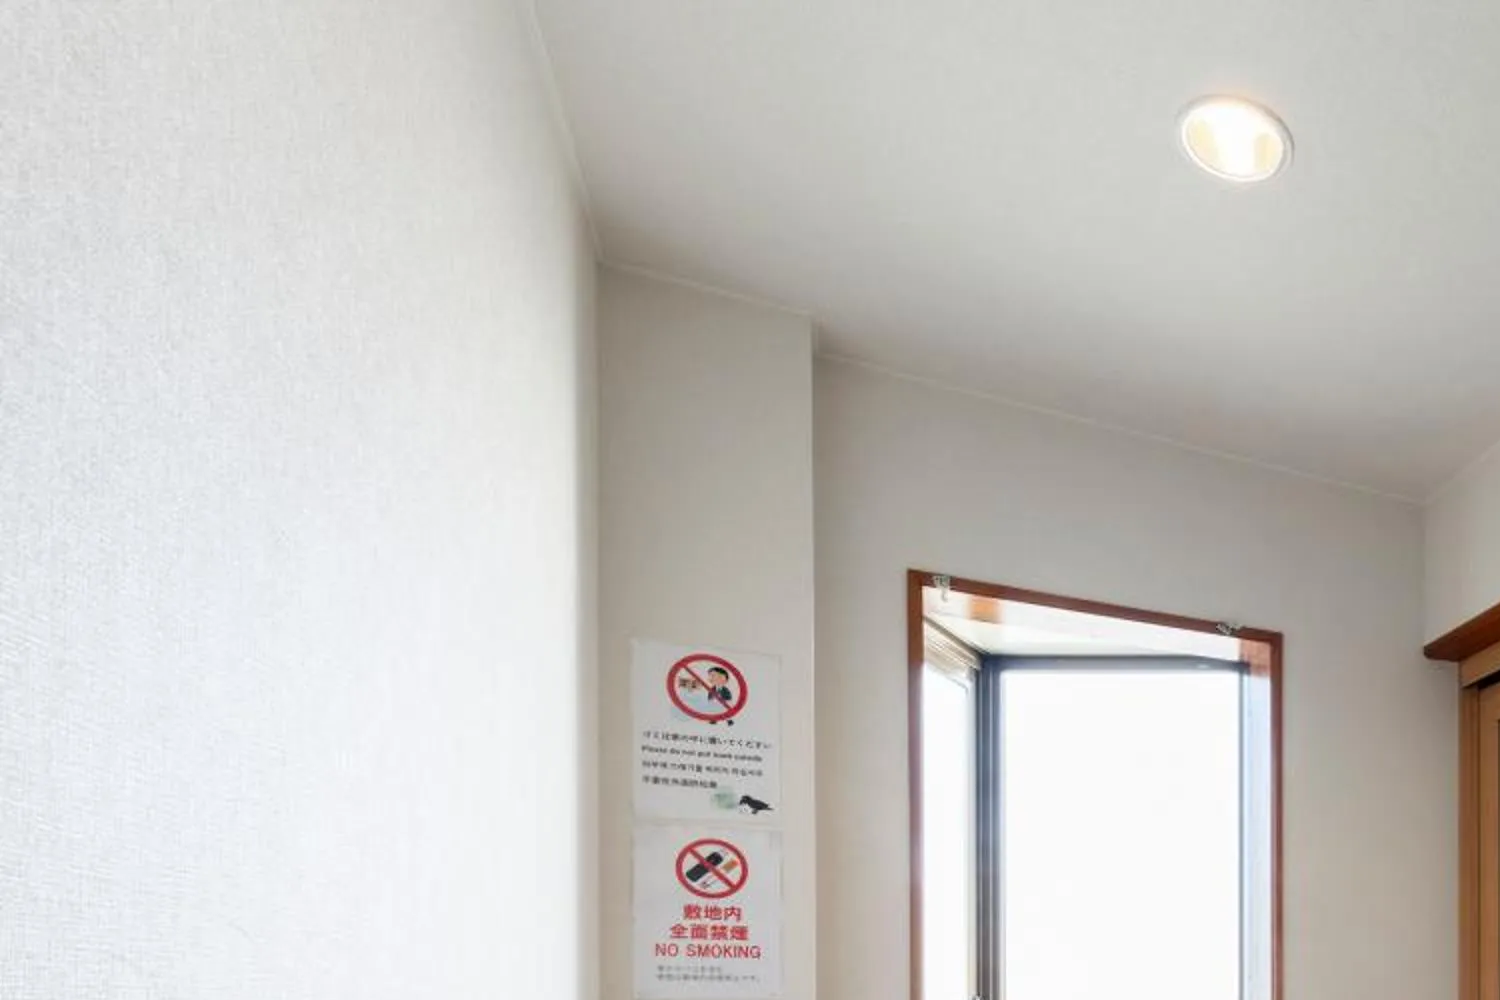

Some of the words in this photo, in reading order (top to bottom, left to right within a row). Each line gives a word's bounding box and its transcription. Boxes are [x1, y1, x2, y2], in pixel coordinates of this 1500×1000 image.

[683, 904, 742, 922] 敷地内
[655, 943, 679, 957] NO
[685, 944, 762, 960] SMOKING
